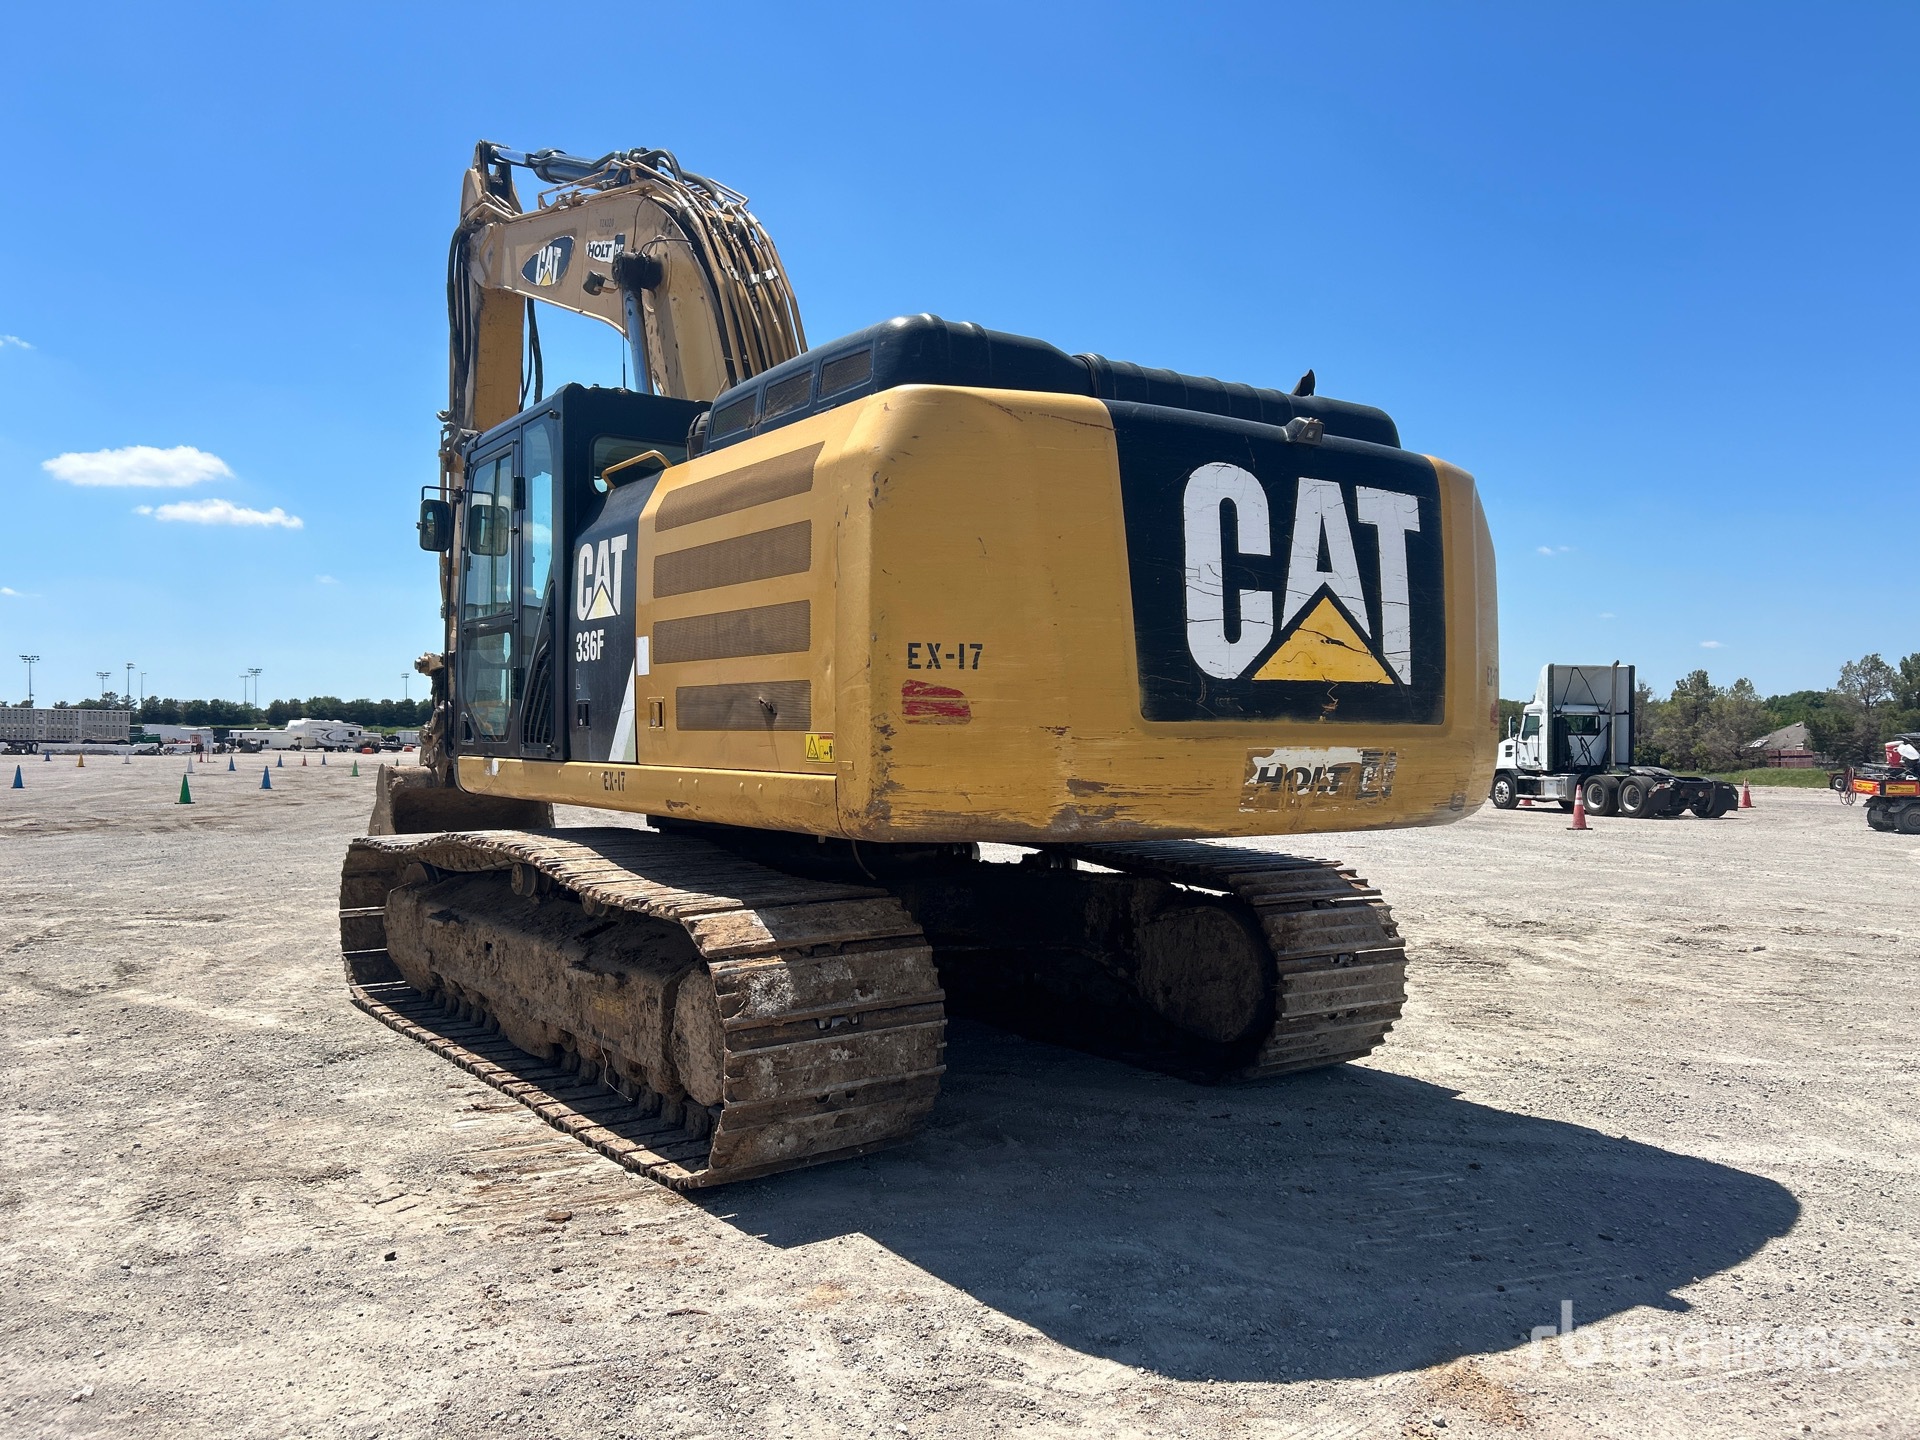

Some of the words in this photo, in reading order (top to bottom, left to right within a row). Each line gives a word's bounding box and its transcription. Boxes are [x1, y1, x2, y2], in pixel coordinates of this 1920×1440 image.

[588, 243, 612, 258] HOLT
[536, 246, 561, 286] CAT
[576, 534, 628, 621] CAT
[1183, 461, 1421, 685] CAT
[575, 629, 604, 662] 336F
[907, 642, 983, 670] EX-17
[603, 770, 626, 792] EX-17
[1255, 766, 1351, 792] HOLT
